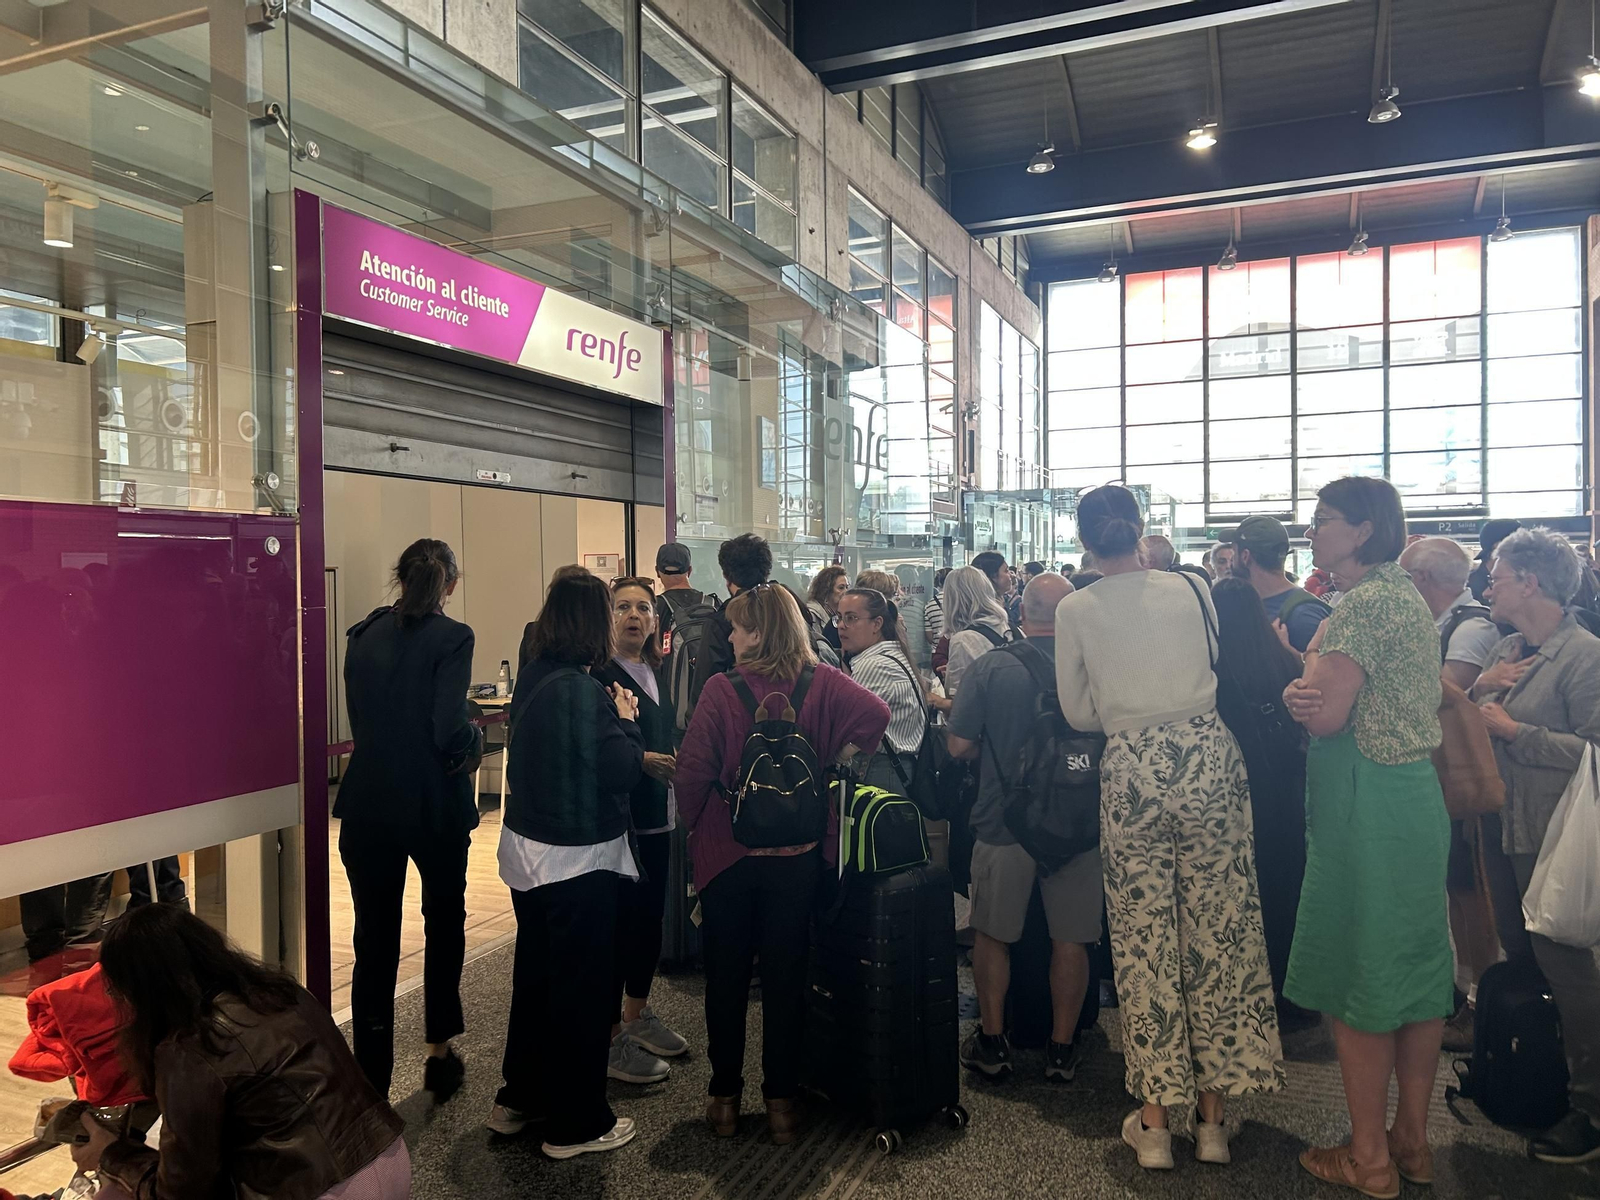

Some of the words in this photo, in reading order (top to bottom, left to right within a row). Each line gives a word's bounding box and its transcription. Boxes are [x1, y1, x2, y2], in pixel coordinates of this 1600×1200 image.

[360, 250, 436, 294] Atención
[441, 279, 457, 301] al
[461, 285, 509, 318] cliente
[360, 279, 424, 313] Customer
[426, 299, 469, 327] Service
[566, 328, 642, 379] renfe
[1438, 522, 1452, 531] P2
[1066, 754, 1090, 770] SKI
